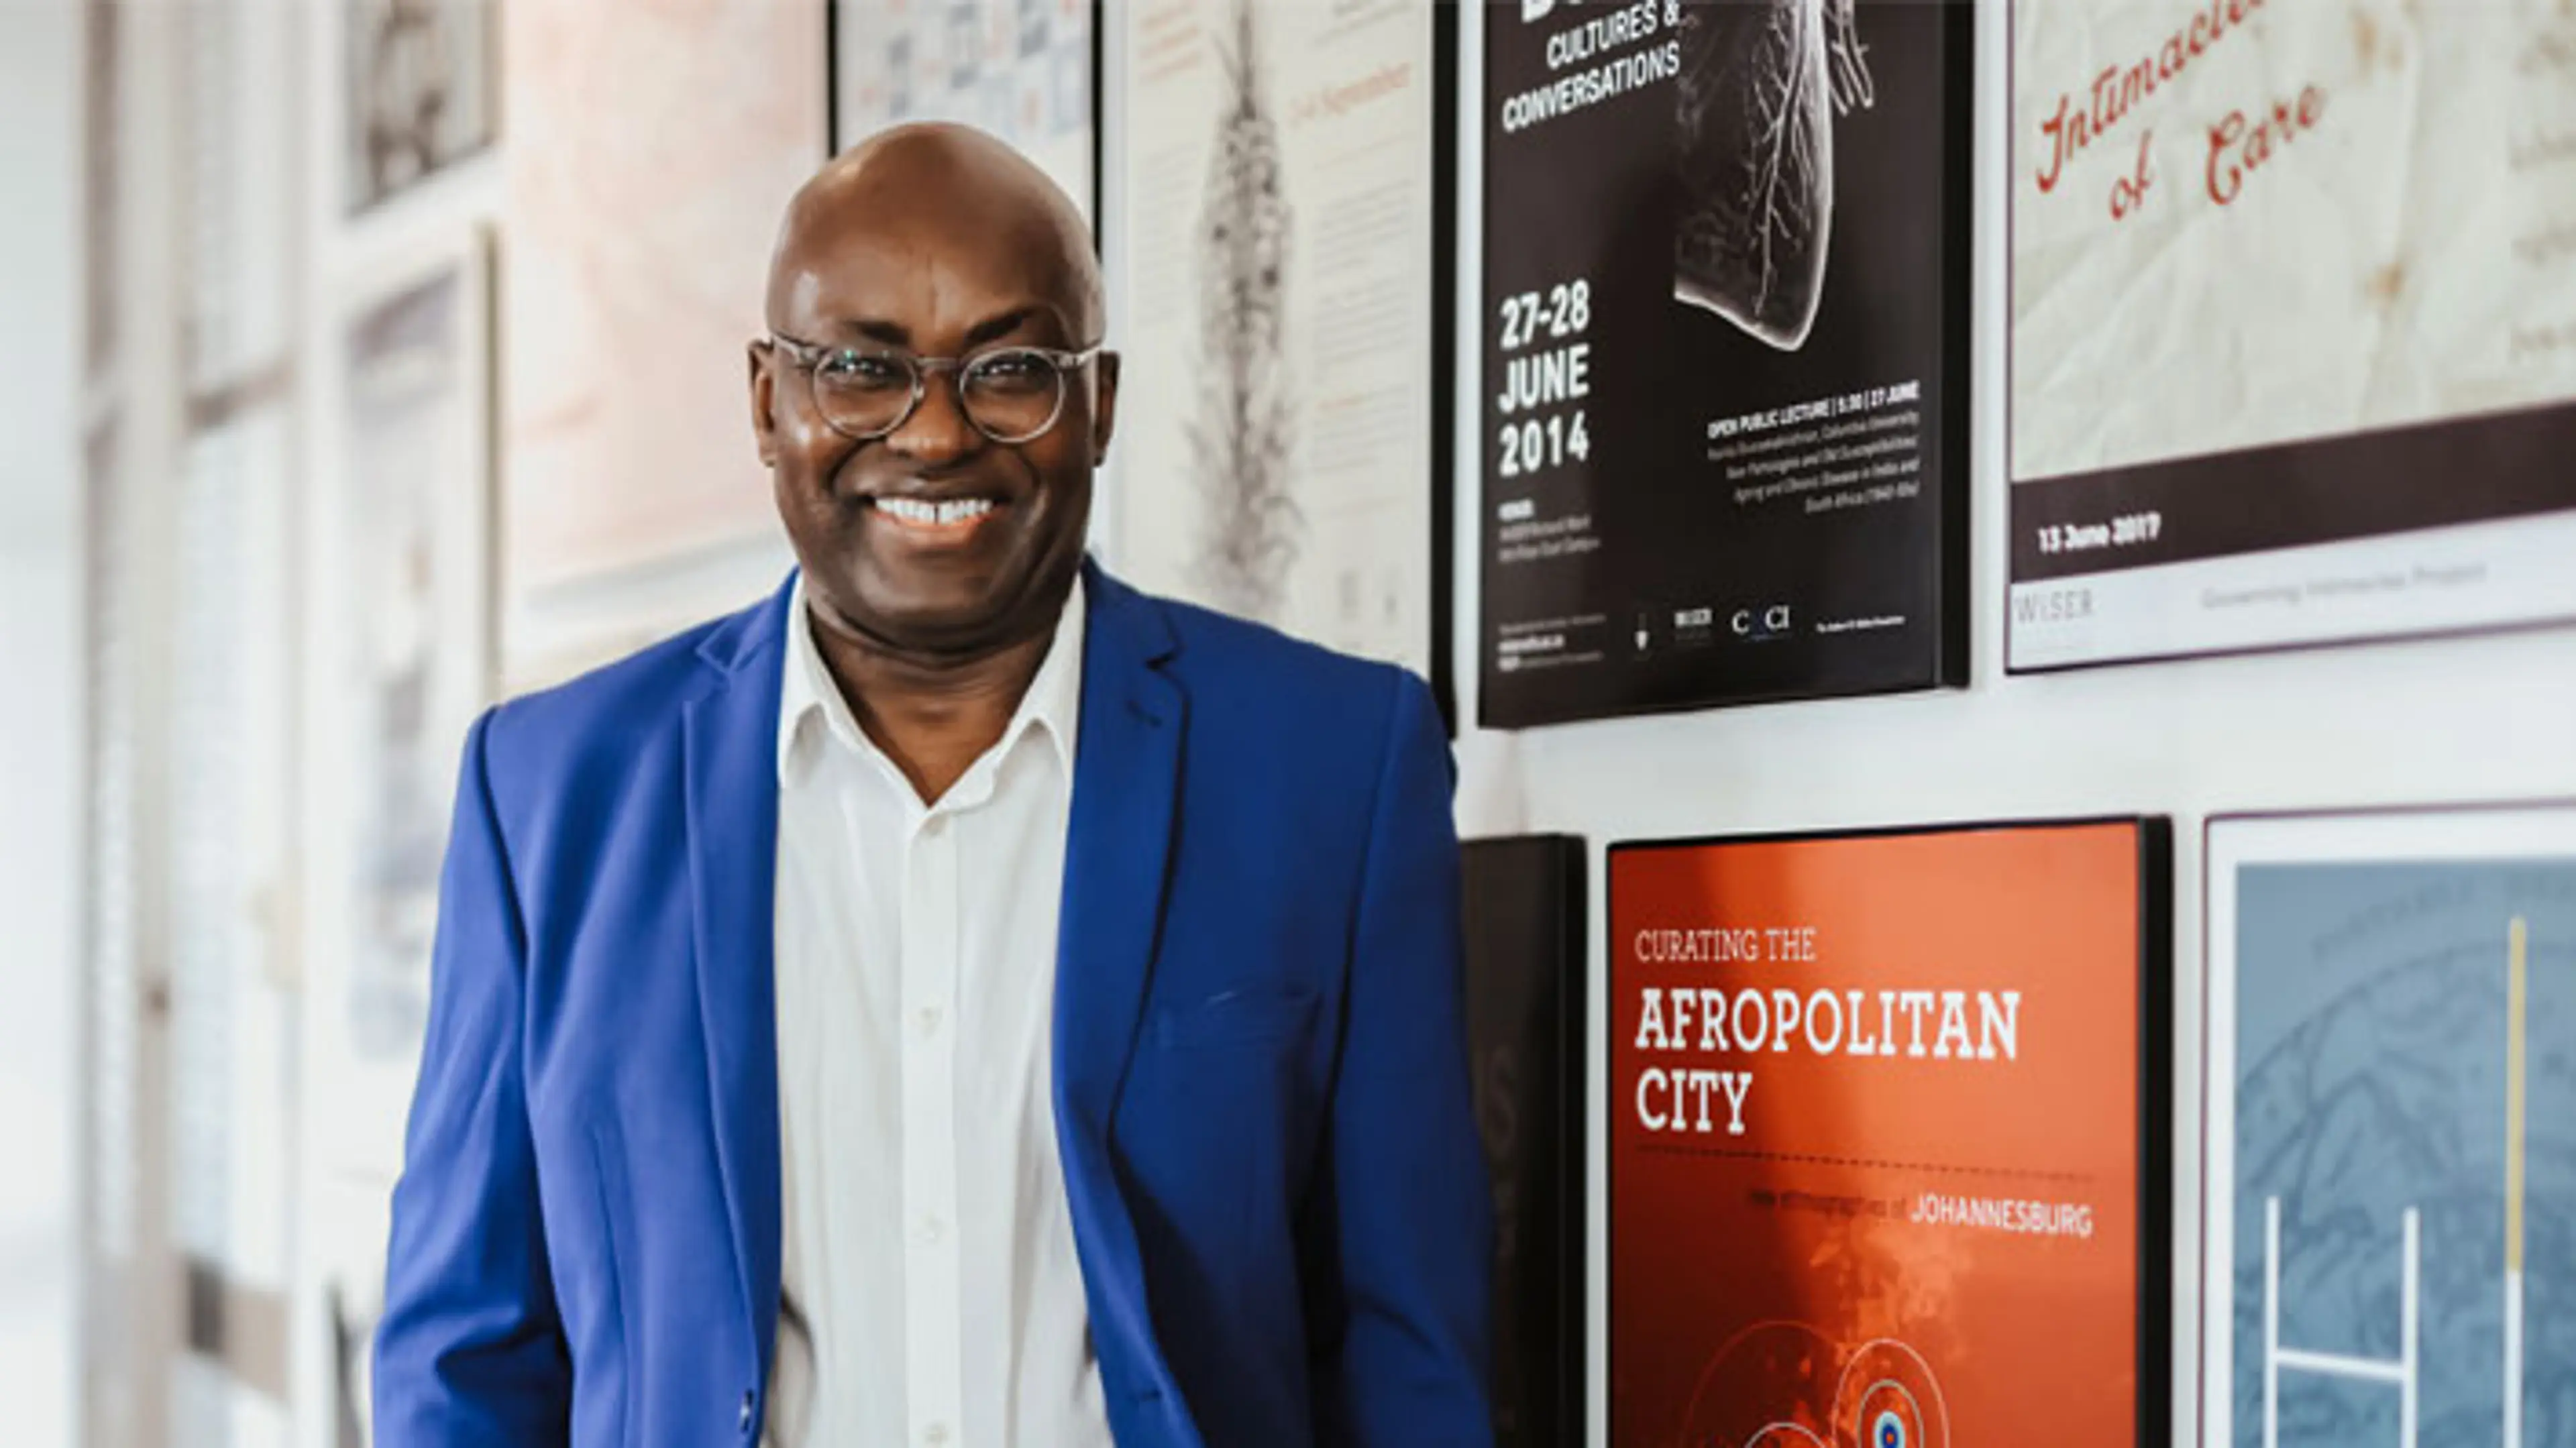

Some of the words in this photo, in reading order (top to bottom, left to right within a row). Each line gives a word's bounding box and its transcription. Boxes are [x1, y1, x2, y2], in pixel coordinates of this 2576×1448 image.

[1547, 0, 1658, 69] CULTURES
[1502, 40, 1680, 132] CONVERSATIONS
[2110, 129, 2154, 221] of
[2205, 84, 2325, 205] Care
[1500, 279, 1590, 349] 27-28
[1498, 343, 1590, 413] JUNE
[1707, 419, 1737, 439] OPEN
[1740, 408, 1778, 432] PUBLIC
[1780, 398, 1829, 425] LECTURE
[1886, 379, 1919, 406] JUNE
[1499, 410, 1590, 478] 2014
[2064, 522, 2110, 552] June
[1635, 928, 1759, 963] CURATING
[1764, 926, 1817, 962] THE
[1634, 987, 2022, 1060] AFROPOLITAN
[1636, 1067, 1753, 1135] CITY
[1911, 1192, 2094, 1237] JOHANNESBURG
